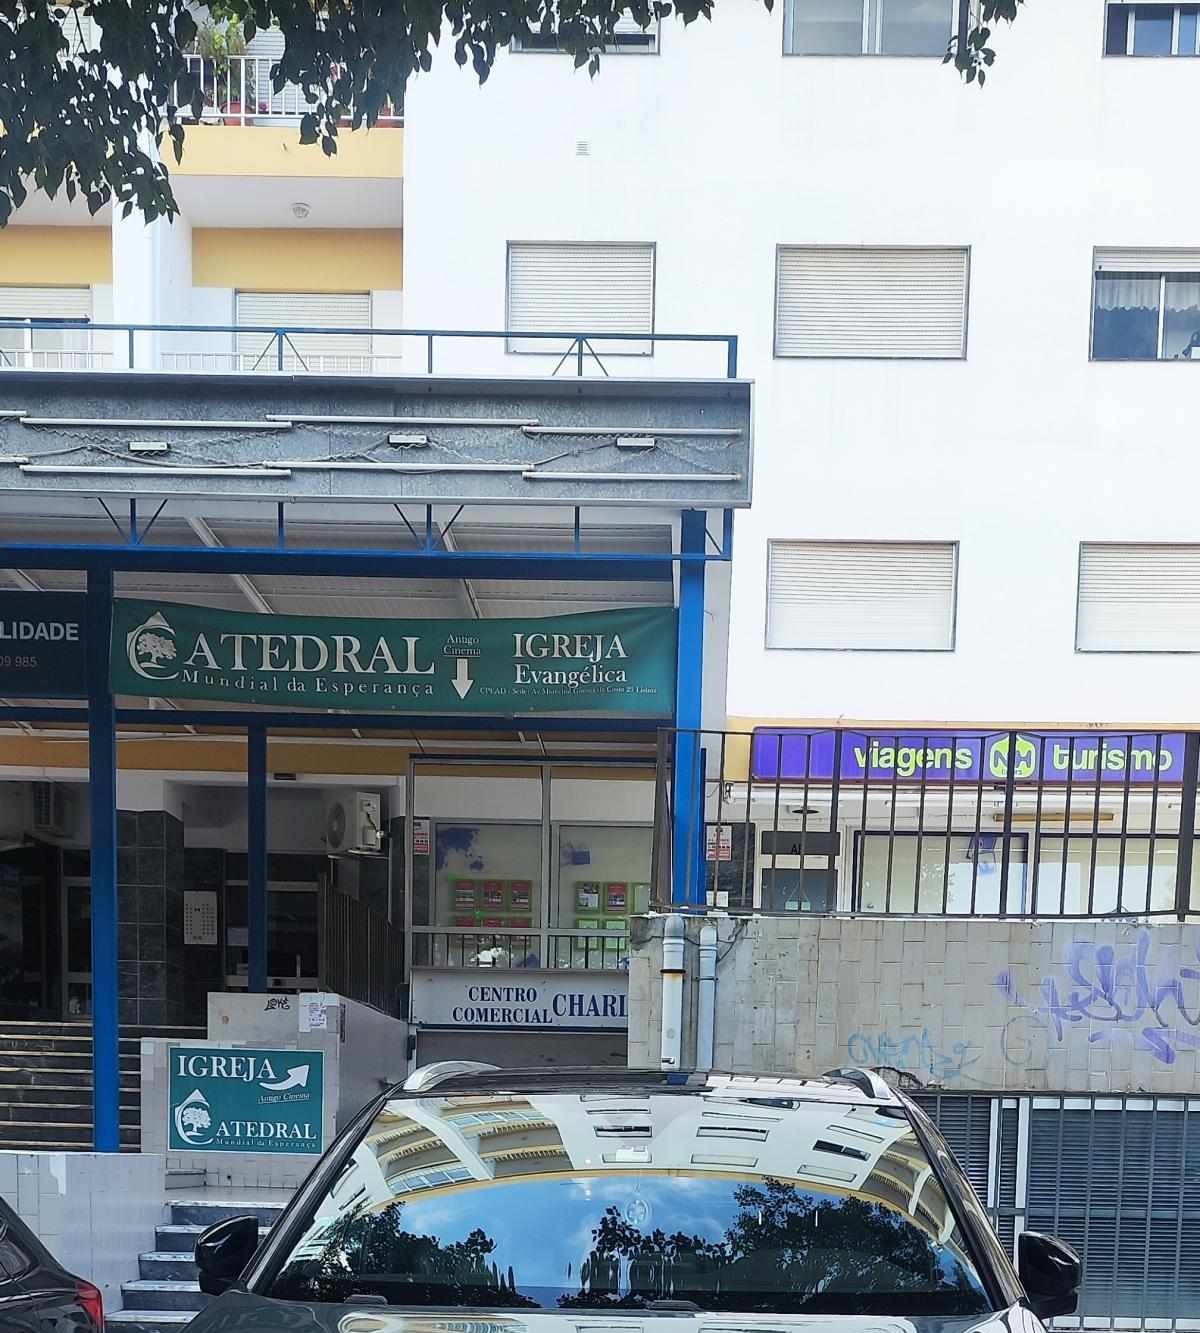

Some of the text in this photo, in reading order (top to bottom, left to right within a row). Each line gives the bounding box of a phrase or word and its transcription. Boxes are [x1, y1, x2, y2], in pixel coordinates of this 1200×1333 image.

[443, 645, 481, 655] Cinema
[447, 633, 480, 646] Antigo
[512, 633, 629, 662] IGREJA
[182, 669, 434, 697] Mundial da Esperança
[514, 664, 628, 687] Evangélica
[853, 741, 973, 777] viagens
[1053, 743, 1174, 771] turismo
[468, 986, 538, 1003] CENTRO
[452, 1007, 553, 1024] COMERCIAL
[177, 1055, 277, 1081] IGREJA
